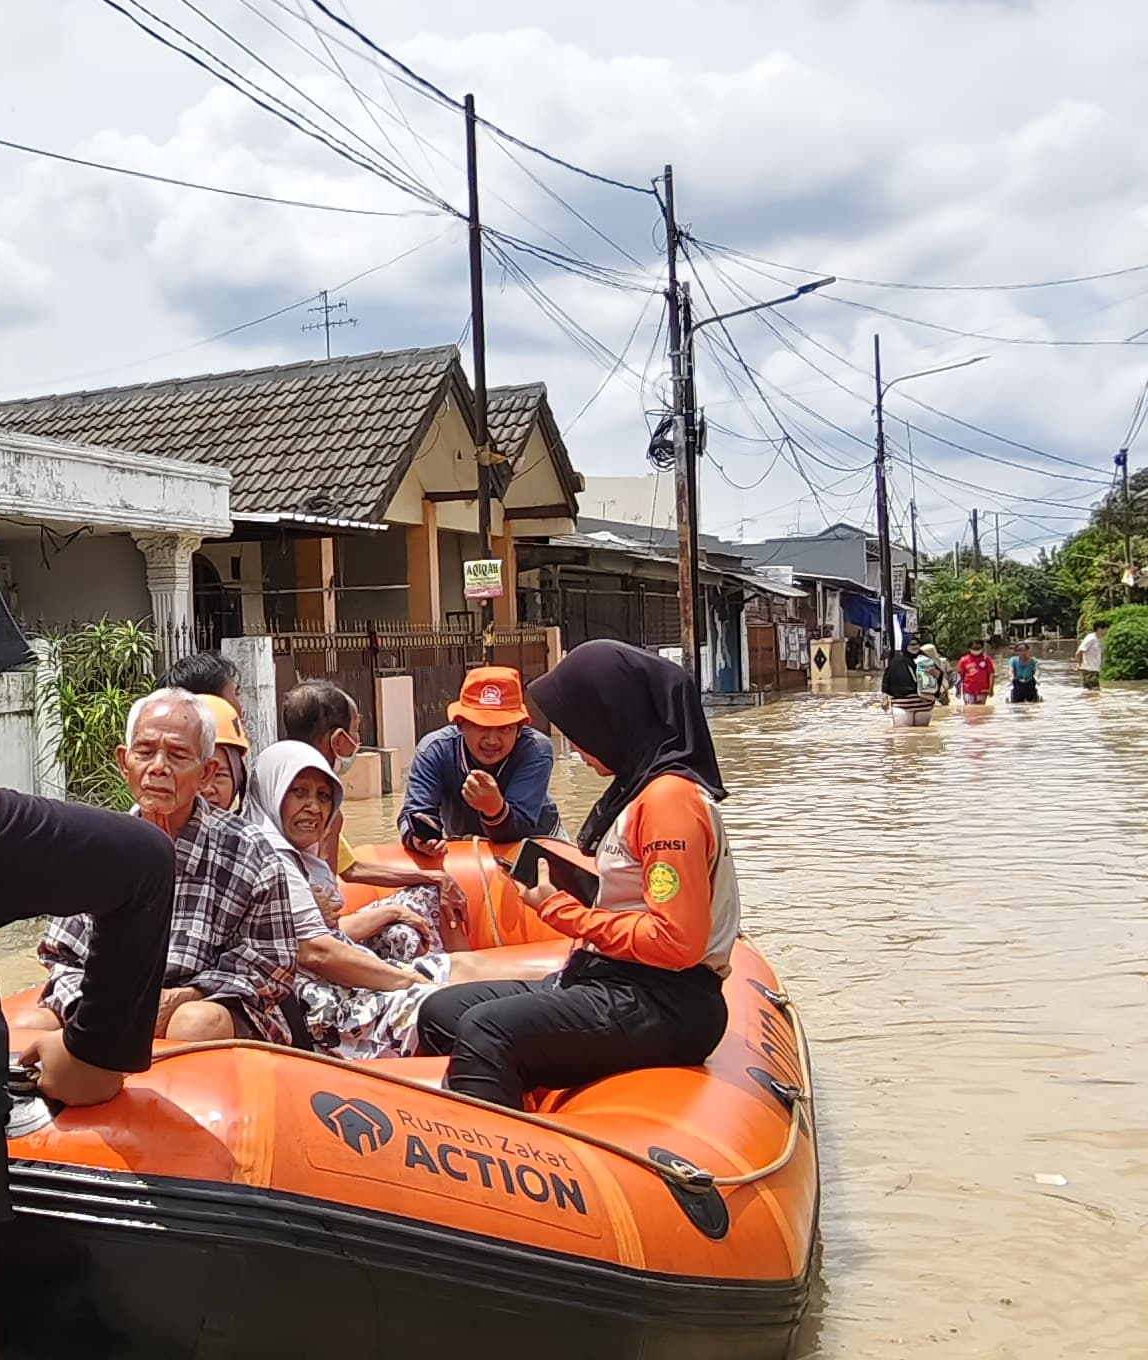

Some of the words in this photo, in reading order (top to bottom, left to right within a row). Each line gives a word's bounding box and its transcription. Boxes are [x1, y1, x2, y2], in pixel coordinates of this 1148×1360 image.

[467, 563, 499, 577] AQIQAH
[396, 1109, 493, 1149] Rumah
[495, 1135, 573, 1171] Zakat
[405, 1134, 588, 1215] ACTION
